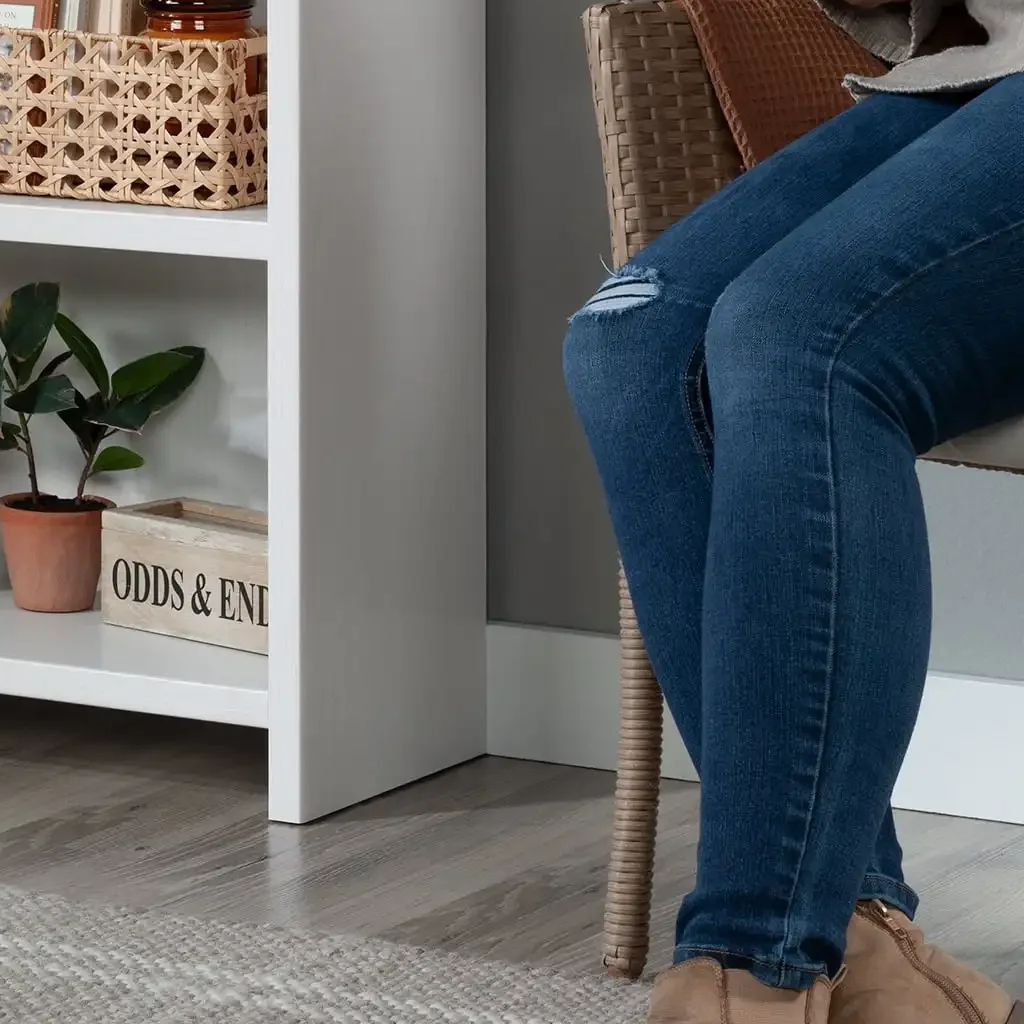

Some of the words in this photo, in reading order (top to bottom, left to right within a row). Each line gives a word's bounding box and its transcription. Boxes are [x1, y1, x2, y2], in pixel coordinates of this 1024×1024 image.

[4, 11, 17, 19] ON
[112, 558, 184, 611] ODDS
[191, 573, 212, 617] &
